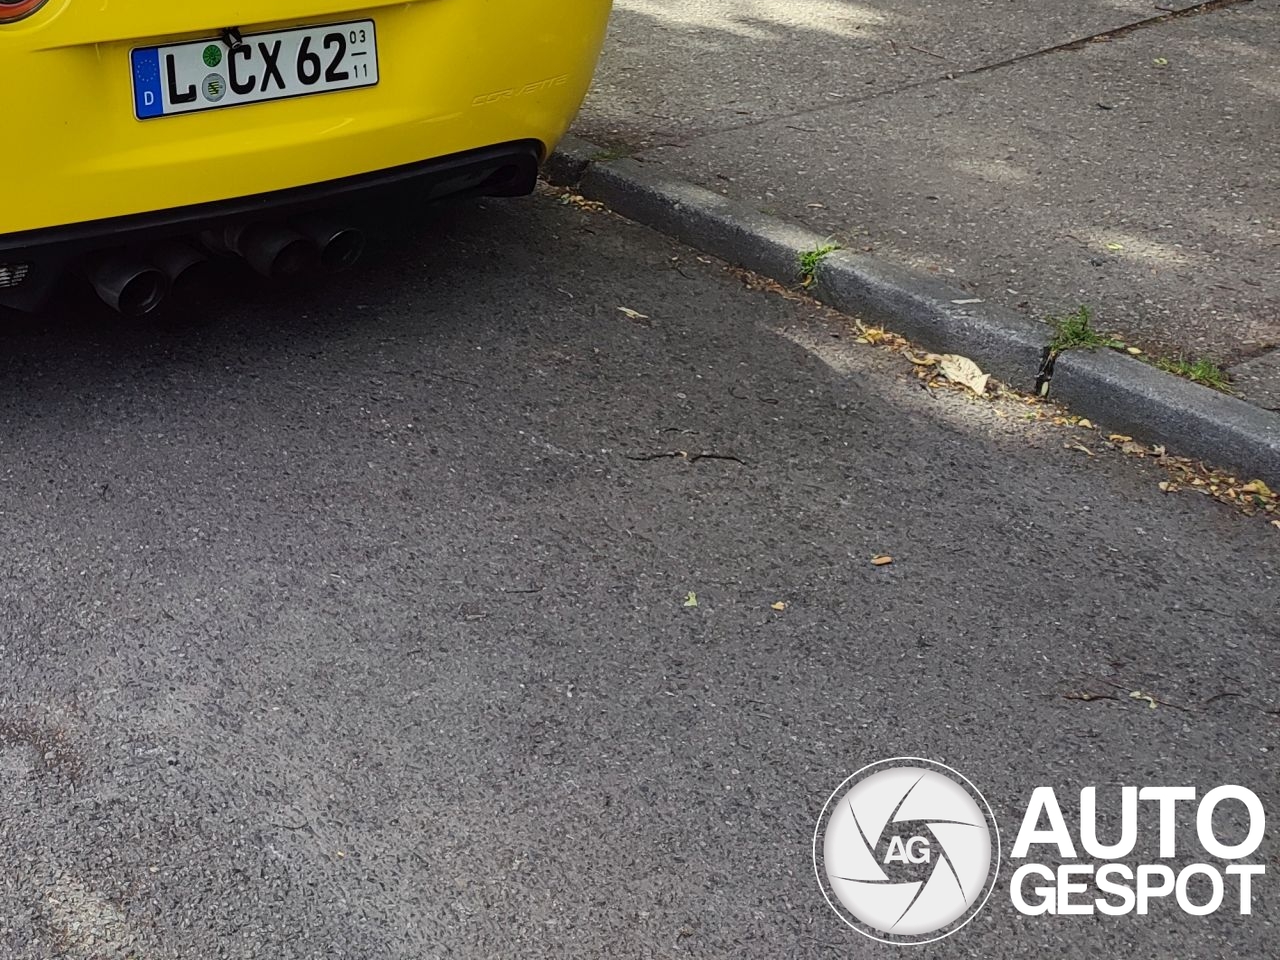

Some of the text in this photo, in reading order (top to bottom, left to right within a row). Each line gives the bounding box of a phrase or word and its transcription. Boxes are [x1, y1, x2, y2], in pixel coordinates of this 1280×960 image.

[349, 29, 366, 44] 03
[144, 32, 349, 106] D L CX 62
[353, 63, 368, 79] 11
